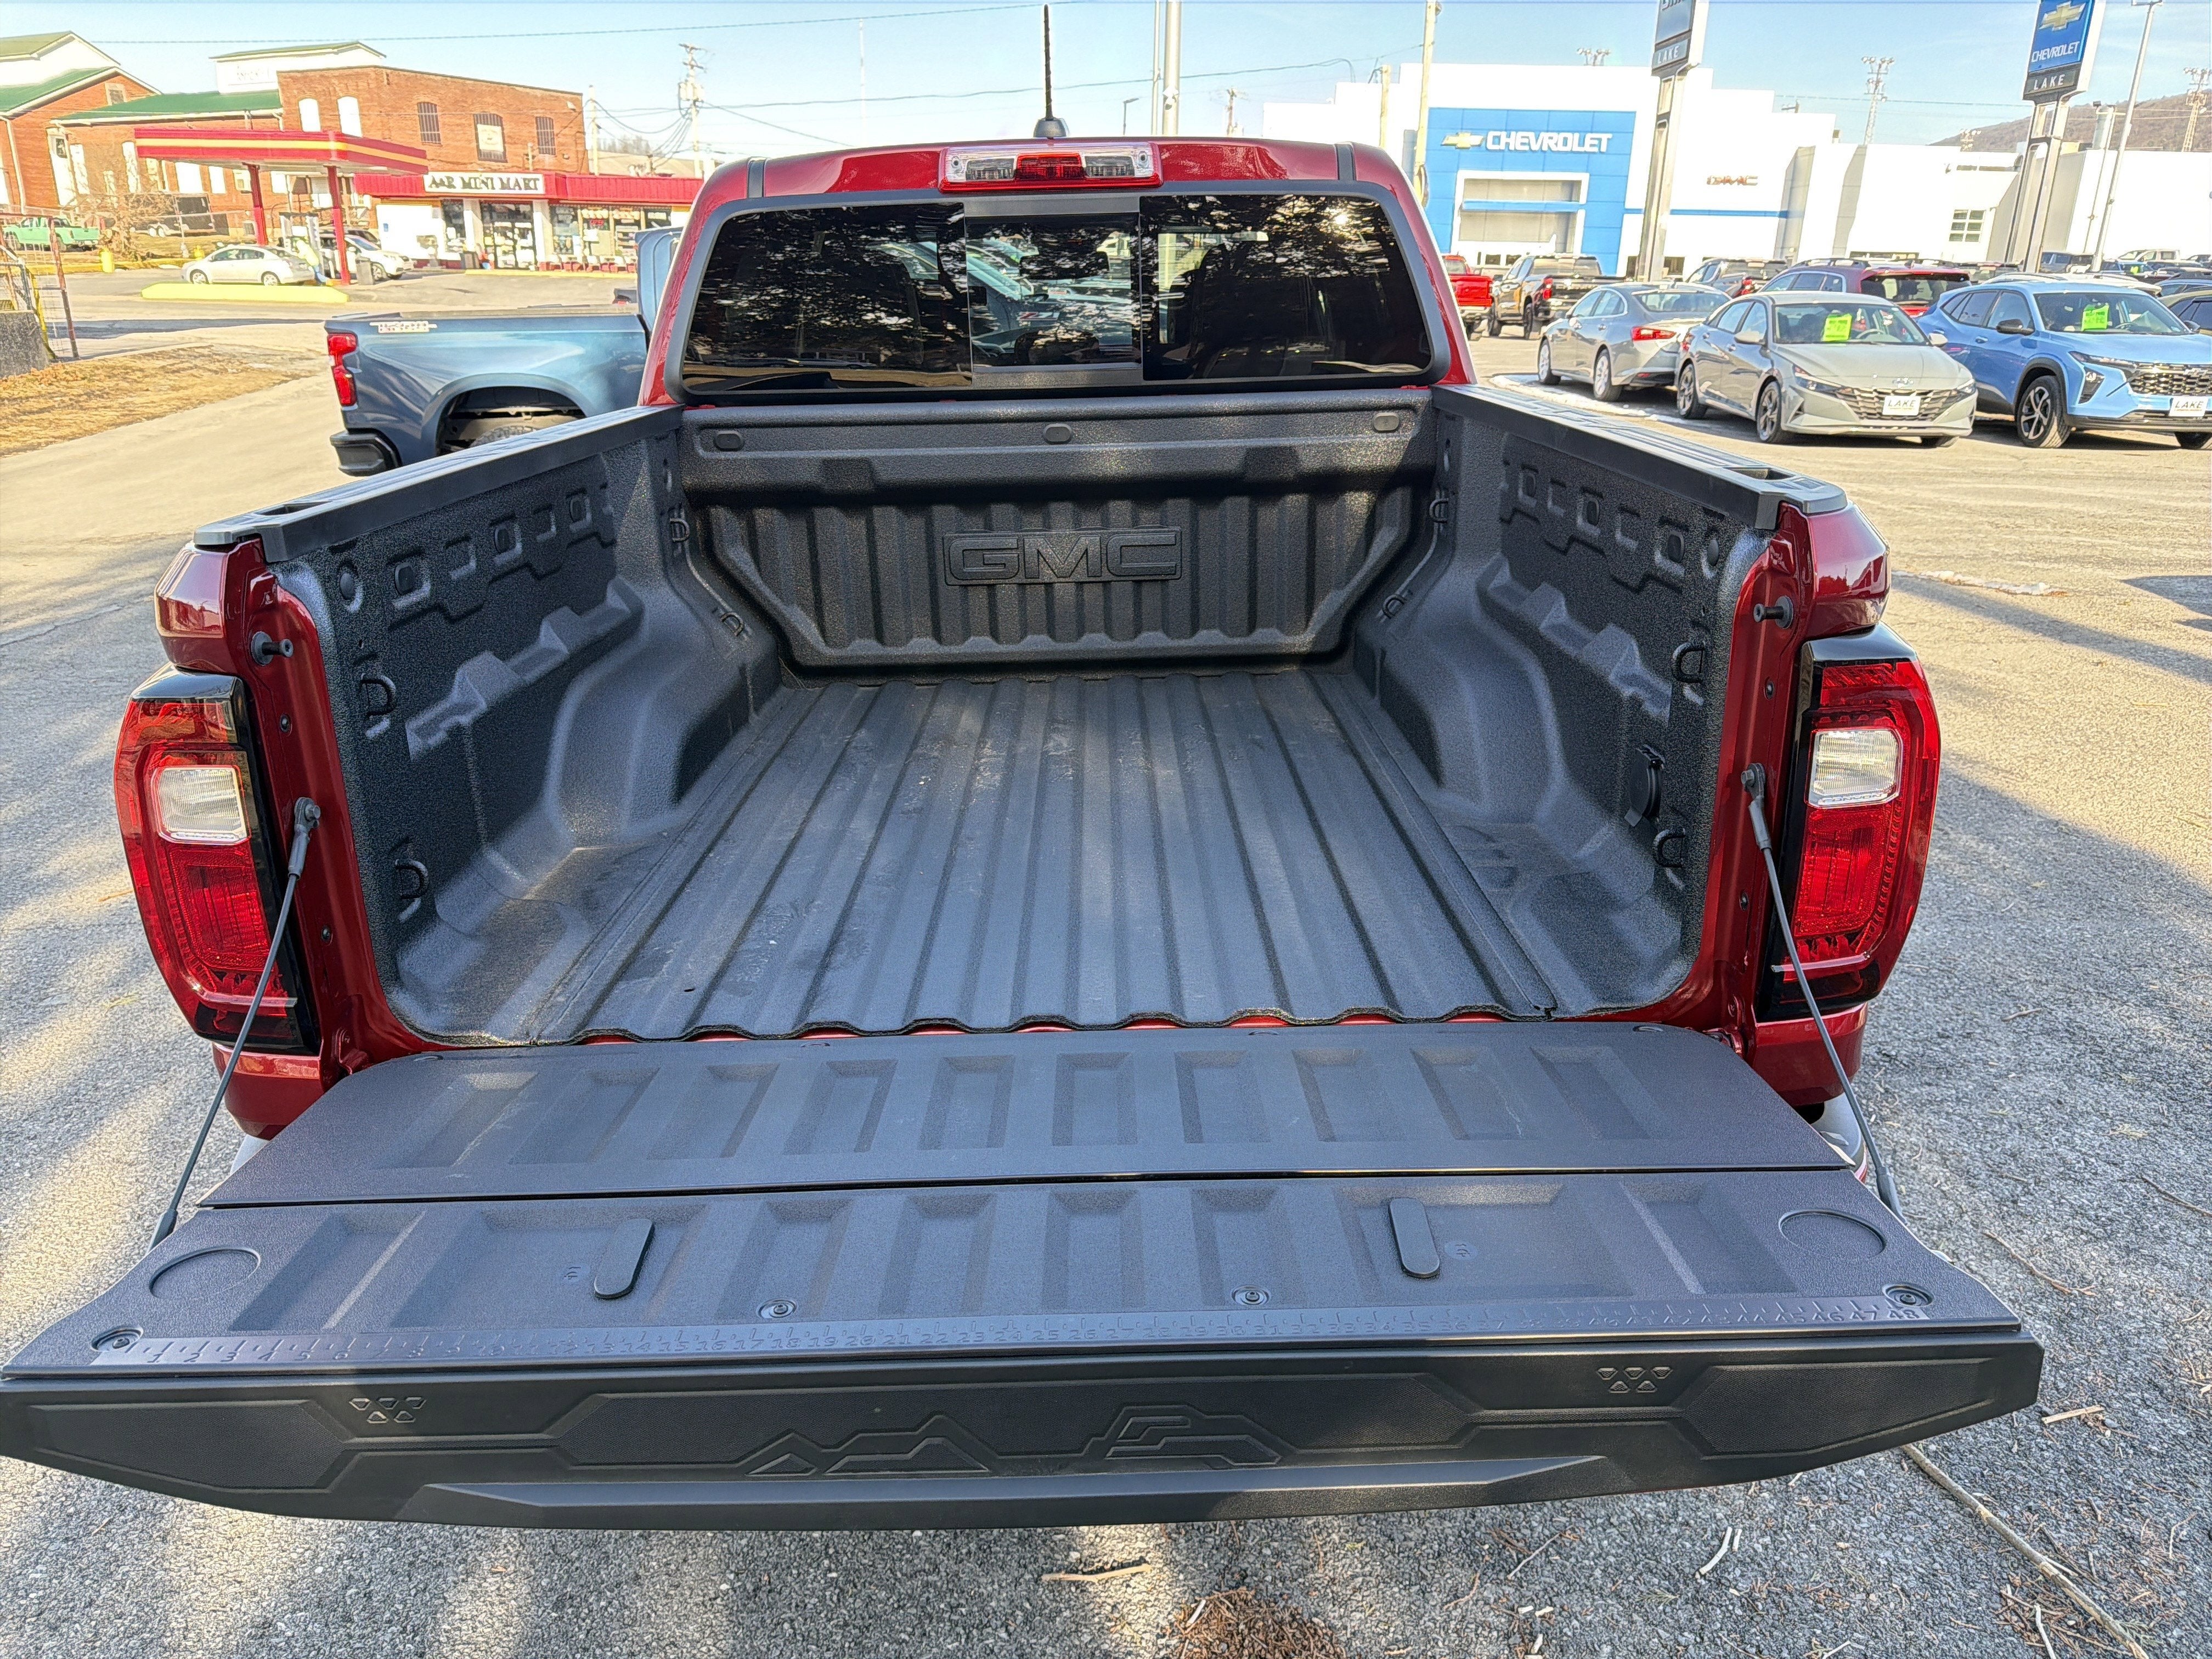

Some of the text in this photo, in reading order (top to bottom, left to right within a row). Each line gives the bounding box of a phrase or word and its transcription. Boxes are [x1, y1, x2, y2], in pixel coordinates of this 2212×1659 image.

[1658, 44, 1679, 64] LAKE
[2031, 41, 2080, 63] CHEVROLET
[2033, 74, 2065, 91] LAKE
[1486, 131, 1613, 153] CHEVROLET
[459, 176, 495, 190] MINI
[498, 177, 540, 191] MART
[2175, 400, 2204, 409] LAKE
[949, 533, 1177, 581] GMC
[146, 1352, 164, 1363] 1
[183, 1352, 201, 1363] 2
[221, 1351, 239, 1362] 3
[257, 1351, 276, 1362] 4
[294, 1351, 314, 1362] 5
[332, 1350, 349, 1361] 6
[658, 1341, 689, 1351] 15
[696, 1340, 727, 1350] 16
[733, 1339, 764, 1350] 17
[771, 1338, 801, 1348] 18
[808, 1336, 838, 1347] 19
[845, 1335, 876, 1346] 20
[882, 1334, 911, 1345] 21
[919, 1333, 949, 1344] 22
[957, 1331, 985, 1342] 23
[993, 1330, 1022, 1341] 24
[1029, 1330, 1059, 1340] 25
[1068, 1329, 1097, 1339] 26
[1105, 1328, 1135, 1339] 27
[1142, 1327, 1171, 1338] 28
[1180, 1327, 1209, 1337] 29
[1217, 1325, 1246, 1336] 30
[1254, 1325, 1282, 1335] 31
[1290, 1324, 1321, 1334] 32
[1328, 1323, 1356, 1334] 33
[1364, 1322, 1395, 1333] 34
[1402, 1321, 1431, 1331] 35
[1737, 1313, 1766, 1323] 44
[1774, 1313, 1805, 1323] 45
[1812, 1311, 1844, 1322] 46
[1849, 1311, 1877, 1321] 47
[1887, 1310, 1920, 1320] 48
